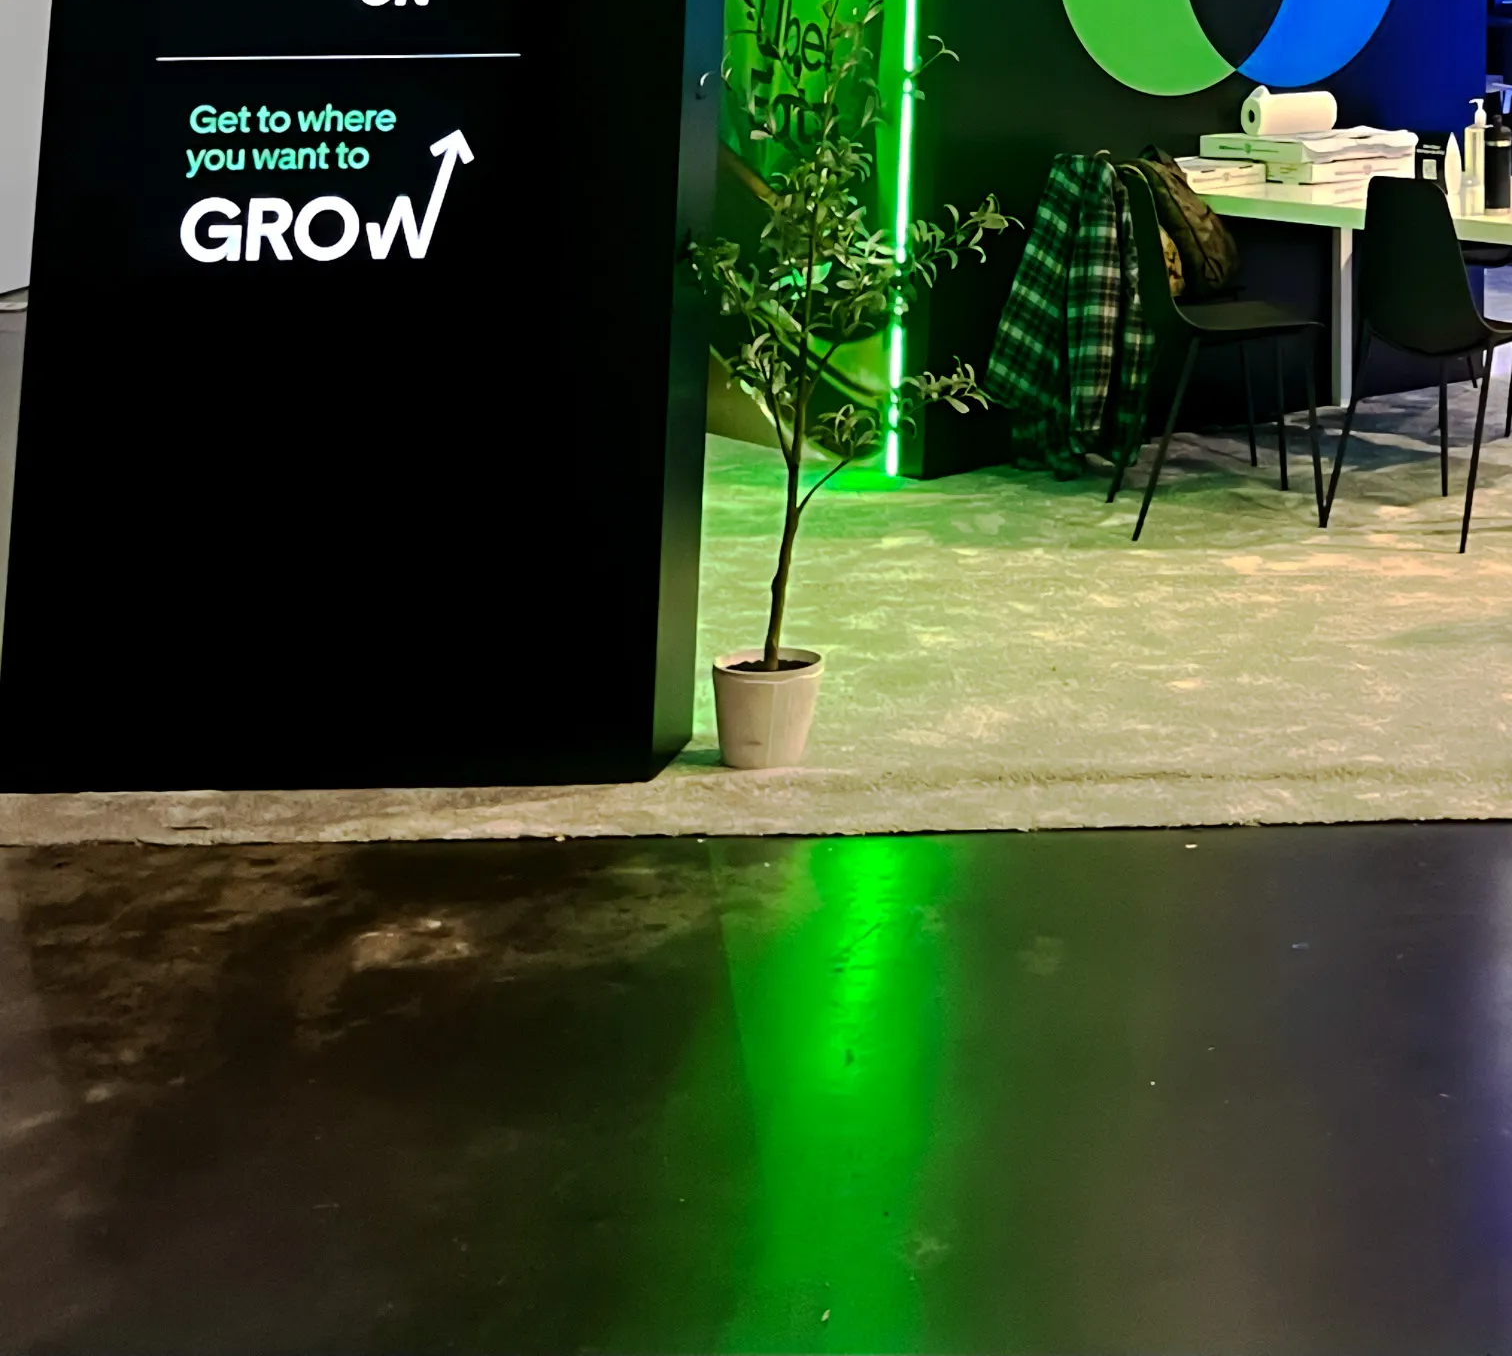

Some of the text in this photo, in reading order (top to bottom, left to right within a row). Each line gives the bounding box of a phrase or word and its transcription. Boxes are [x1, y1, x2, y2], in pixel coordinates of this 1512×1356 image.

[188, 102, 397, 134] Get to where
[185, 141, 370, 179] you want to
[180, 147, 452, 263] GROW
